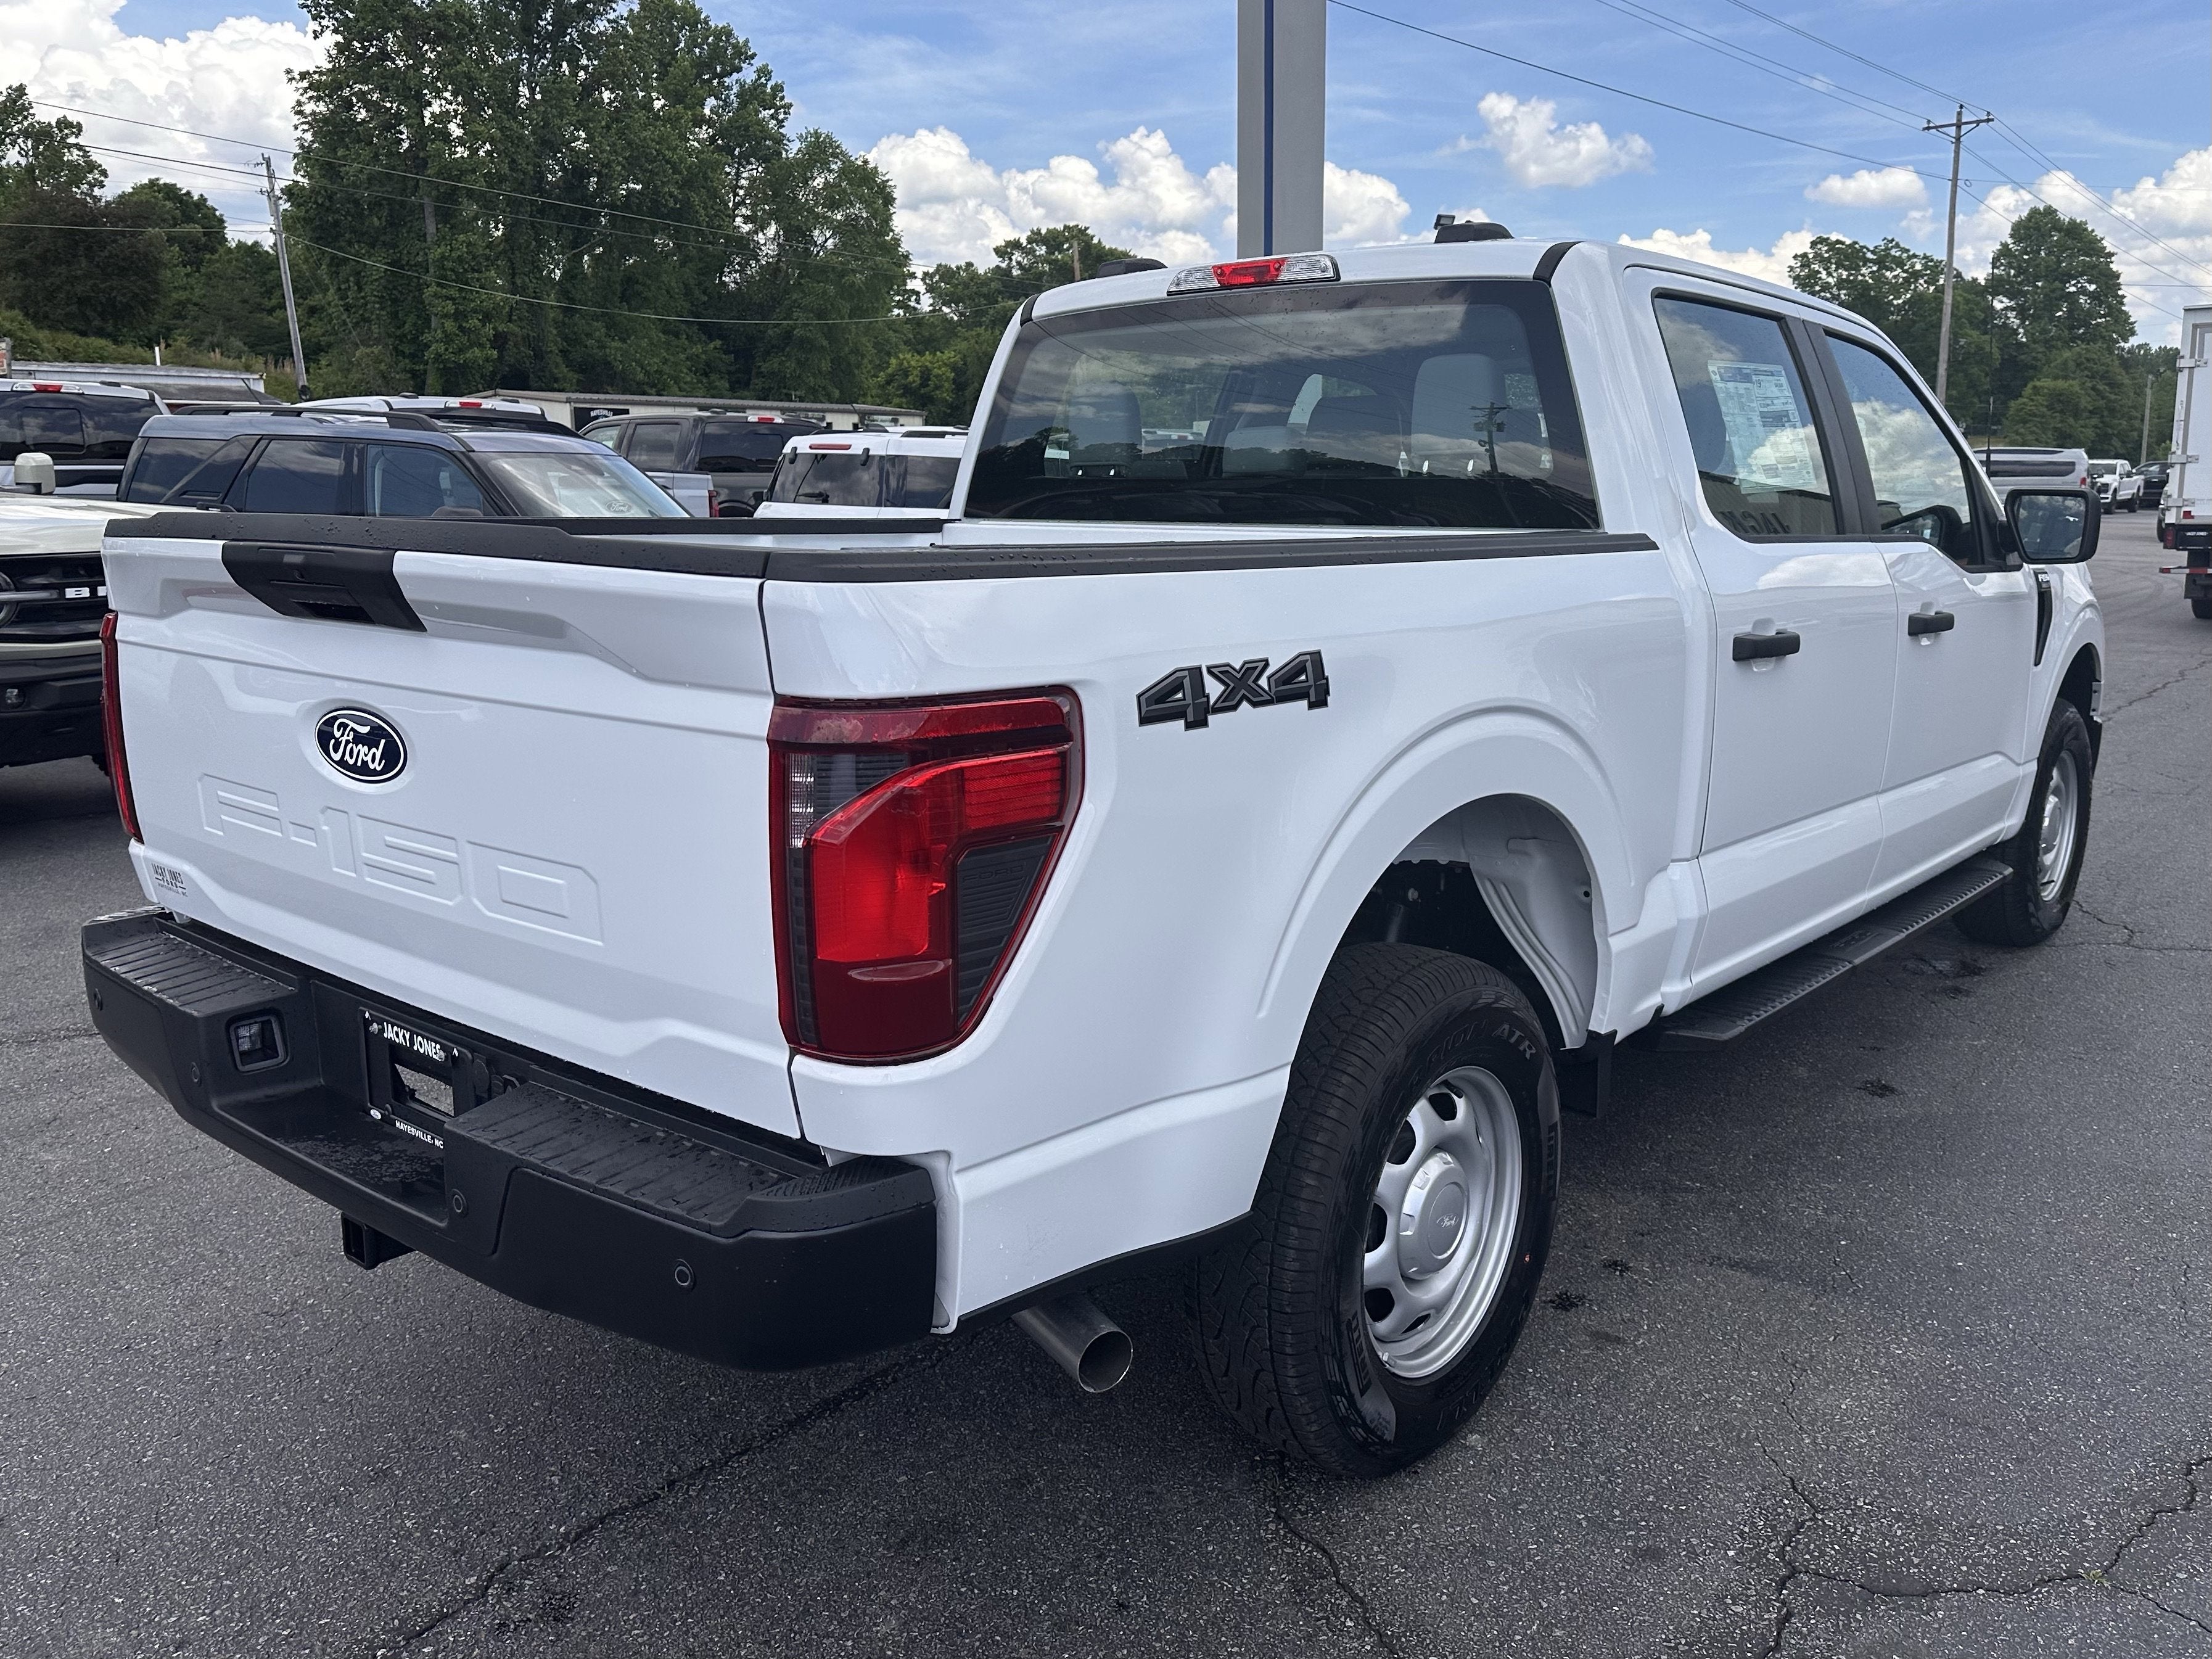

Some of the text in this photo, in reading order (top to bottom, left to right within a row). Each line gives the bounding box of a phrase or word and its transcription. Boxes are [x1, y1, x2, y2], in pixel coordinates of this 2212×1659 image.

[611, 503, 628, 511] Ford
[329, 718, 385, 771] Ford
[197, 773, 604, 945] F-150
[384, 1022, 410, 1047] JACKY
[1492, 1022, 1537, 1060] ATR
[434, 1138, 444, 1149] NC
